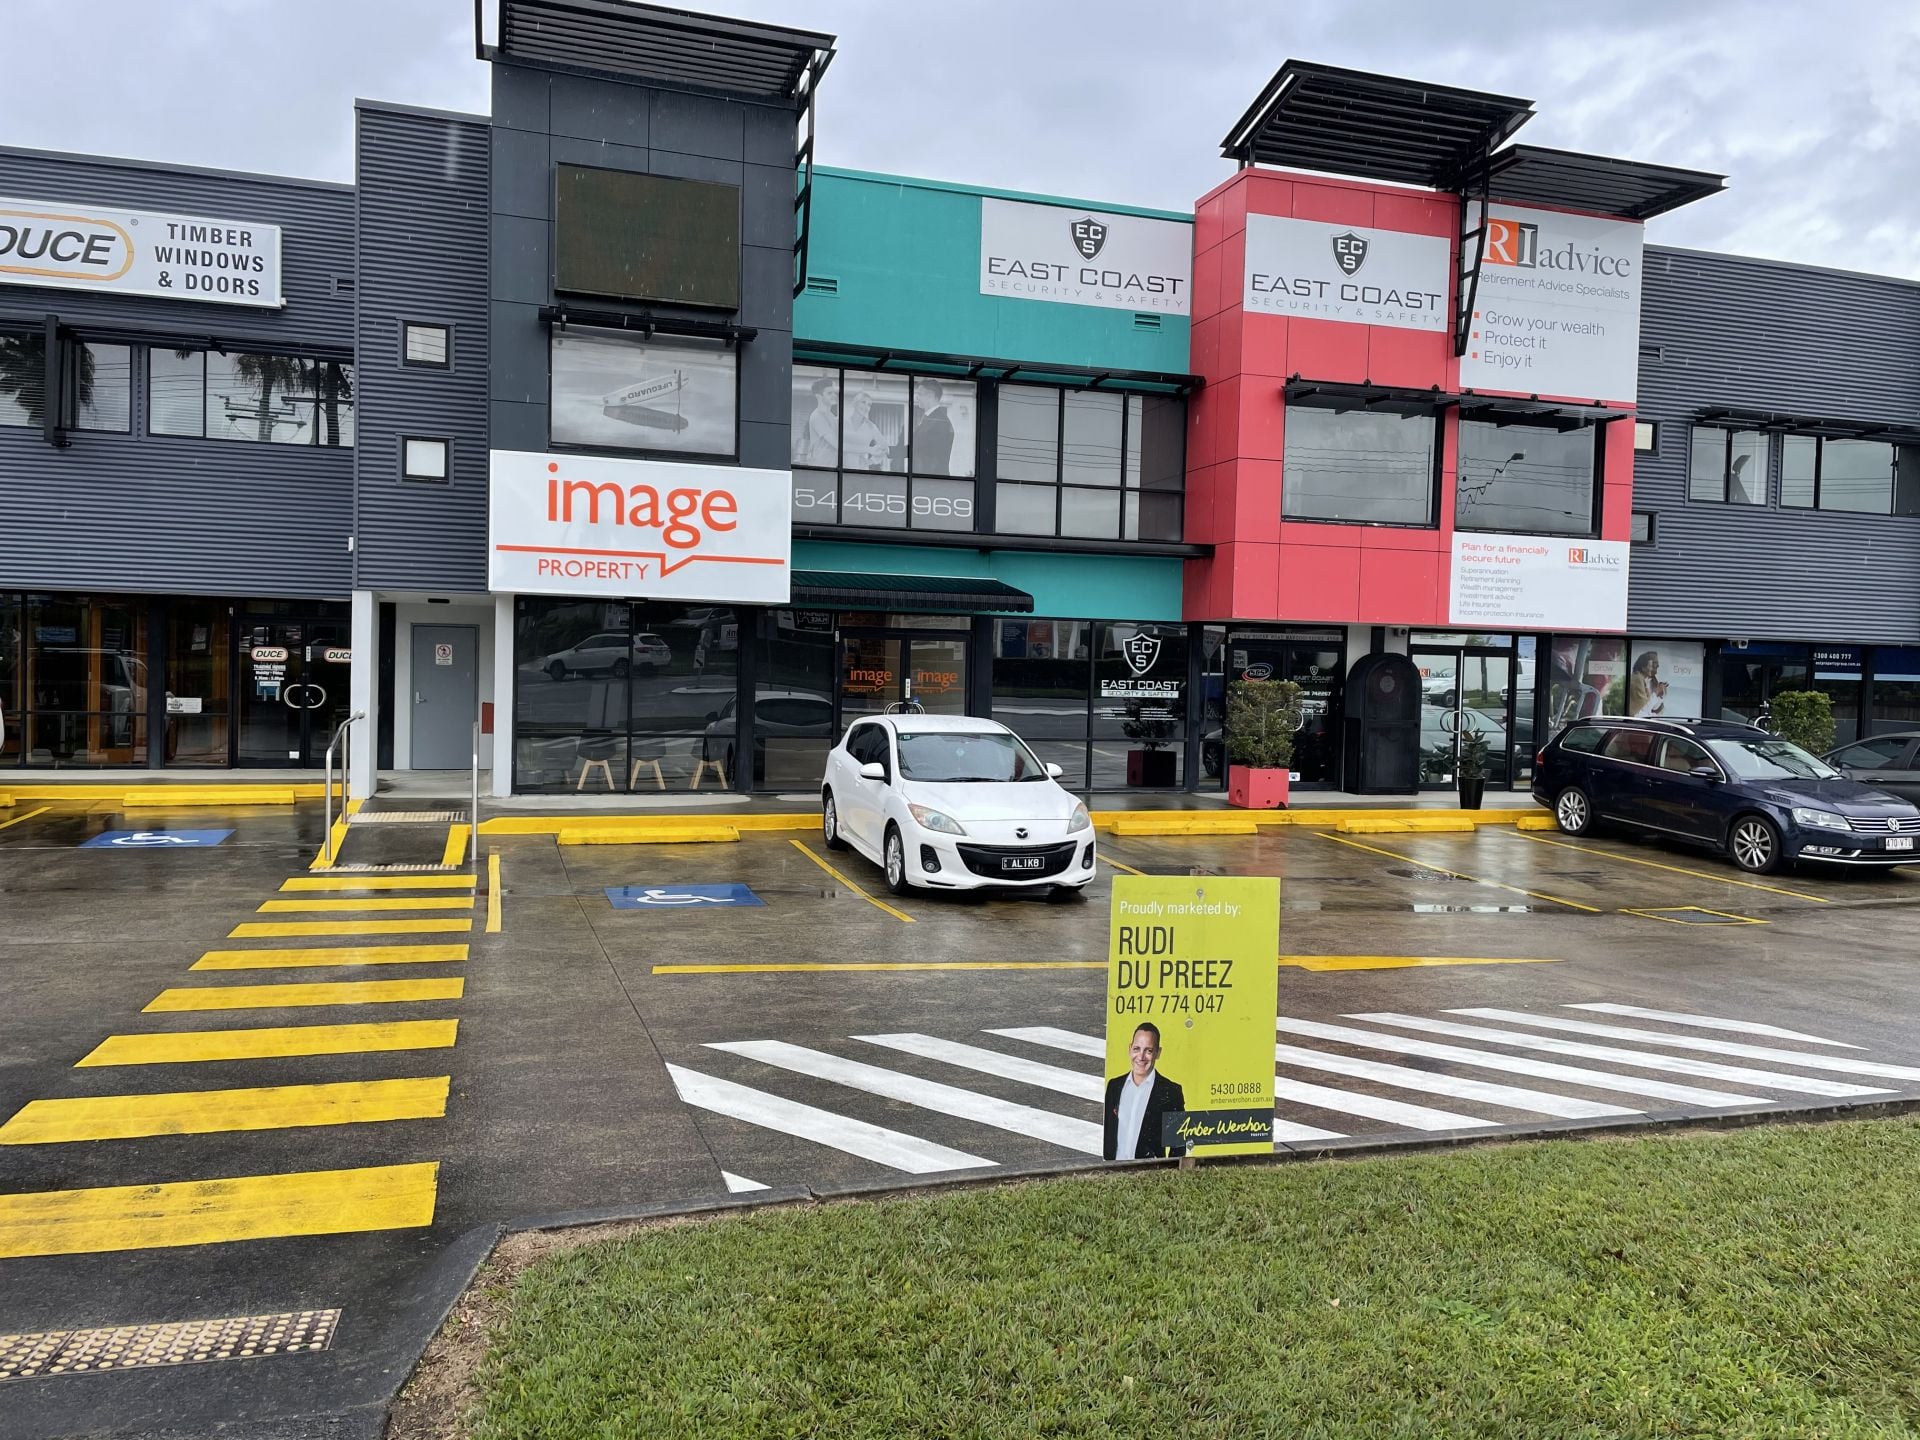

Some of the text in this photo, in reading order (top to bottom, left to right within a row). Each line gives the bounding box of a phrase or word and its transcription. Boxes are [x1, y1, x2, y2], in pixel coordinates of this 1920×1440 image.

[167, 223, 252, 247] TIMBER
[155, 246, 264, 273] WINDOWS
[158, 270, 260, 296] & DOORS
[988, 257, 1184, 295] EAST COAST
[988, 279, 1184, 308] SECURITY & SAFETY
[1252, 273, 1441, 311] EAST COAST
[1538, 279, 1573, 293] Advice
[1576, 283, 1630, 300] Specialists
[1251, 296, 1441, 325] SECURITY & SAFETY
[1485, 311, 1605, 337] Grow your wealth
[1485, 331, 1547, 349] Protect it
[1484, 350, 1532, 368] Enjoy it
[548, 462, 738, 549] image
[795, 488, 972, 518] 54 455 969
[1461, 554, 1521, 565] secure future
[1462, 543, 1481, 551] Plan
[1484, 543, 1497, 552] for
[1507, 545, 1549, 556] financially
[538, 558, 649, 580] PROPERTY
[1460, 566, 1508, 575] Superannuation
[1460, 575, 1521, 585] Retirement planning
[1483, 610, 1514, 618] protection
[255, 650, 284, 658] DUCE
[328, 651, 352, 659] DUC
[850, 666, 893, 686] image
[917, 669, 958, 687] image
[1673, 665, 1692, 675] Enjoy
[1101, 680, 1179, 690] EAST COAST
[1119, 901, 1241, 918] Proudly marketed by:
[1119, 926, 1174, 955] RUDI
[1117, 960, 1233, 989] DU PREEZ
[1115, 994, 1224, 1014] 0417 774 047
[1210, 1082, 1261, 1095] 5430 0888
[1210, 1096, 1273, 1105] amberwerchon.com.au
[1176, 1115, 1272, 1141] Amber Werchon
